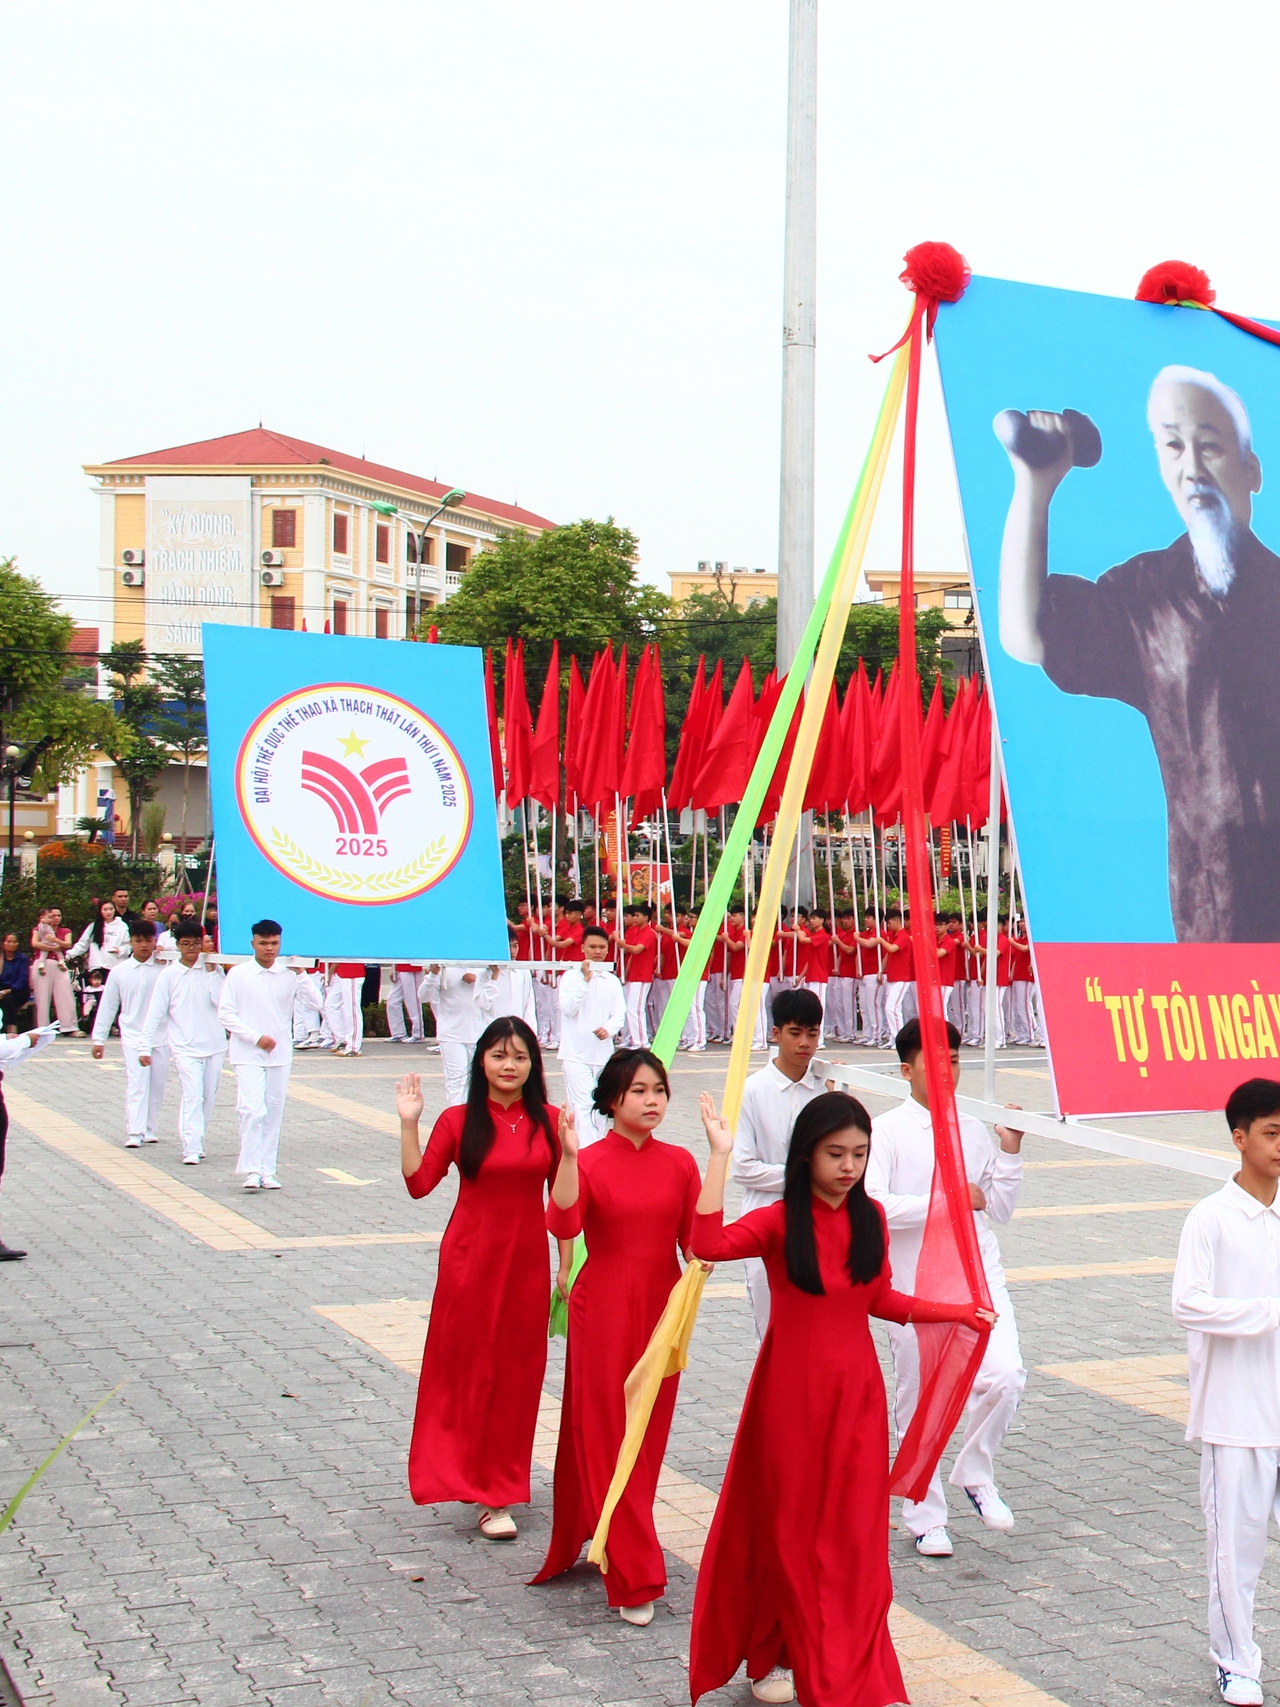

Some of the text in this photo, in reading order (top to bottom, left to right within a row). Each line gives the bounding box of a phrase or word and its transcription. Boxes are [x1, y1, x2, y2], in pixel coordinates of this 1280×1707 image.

[154, 546, 244, 575] TRÁCH NHIỆM,
[162, 582, 238, 612] HÀNH ĐỘNG,
[295, 702, 323, 721] THAO
[322, 696, 338, 713] XÃ
[340, 698, 373, 715] THẠCH
[278, 708, 300, 732] THỂ
[376, 705, 401, 725] THẤT
[264, 727, 285, 749] DỤC
[416, 734, 440, 754] THỨ
[255, 743, 275, 765] THỂ
[429, 752, 441, 760] I
[251, 766, 272, 784] HỘI
[432, 758, 452, 782] NĂM
[254, 787, 272, 803] ĐẠI
[441, 784, 457, 807] 2025
[335, 837, 388, 857] 2025
[1085, 976, 1150, 1078] “TỰ
[1152, 980, 1207, 1062] TÔI
